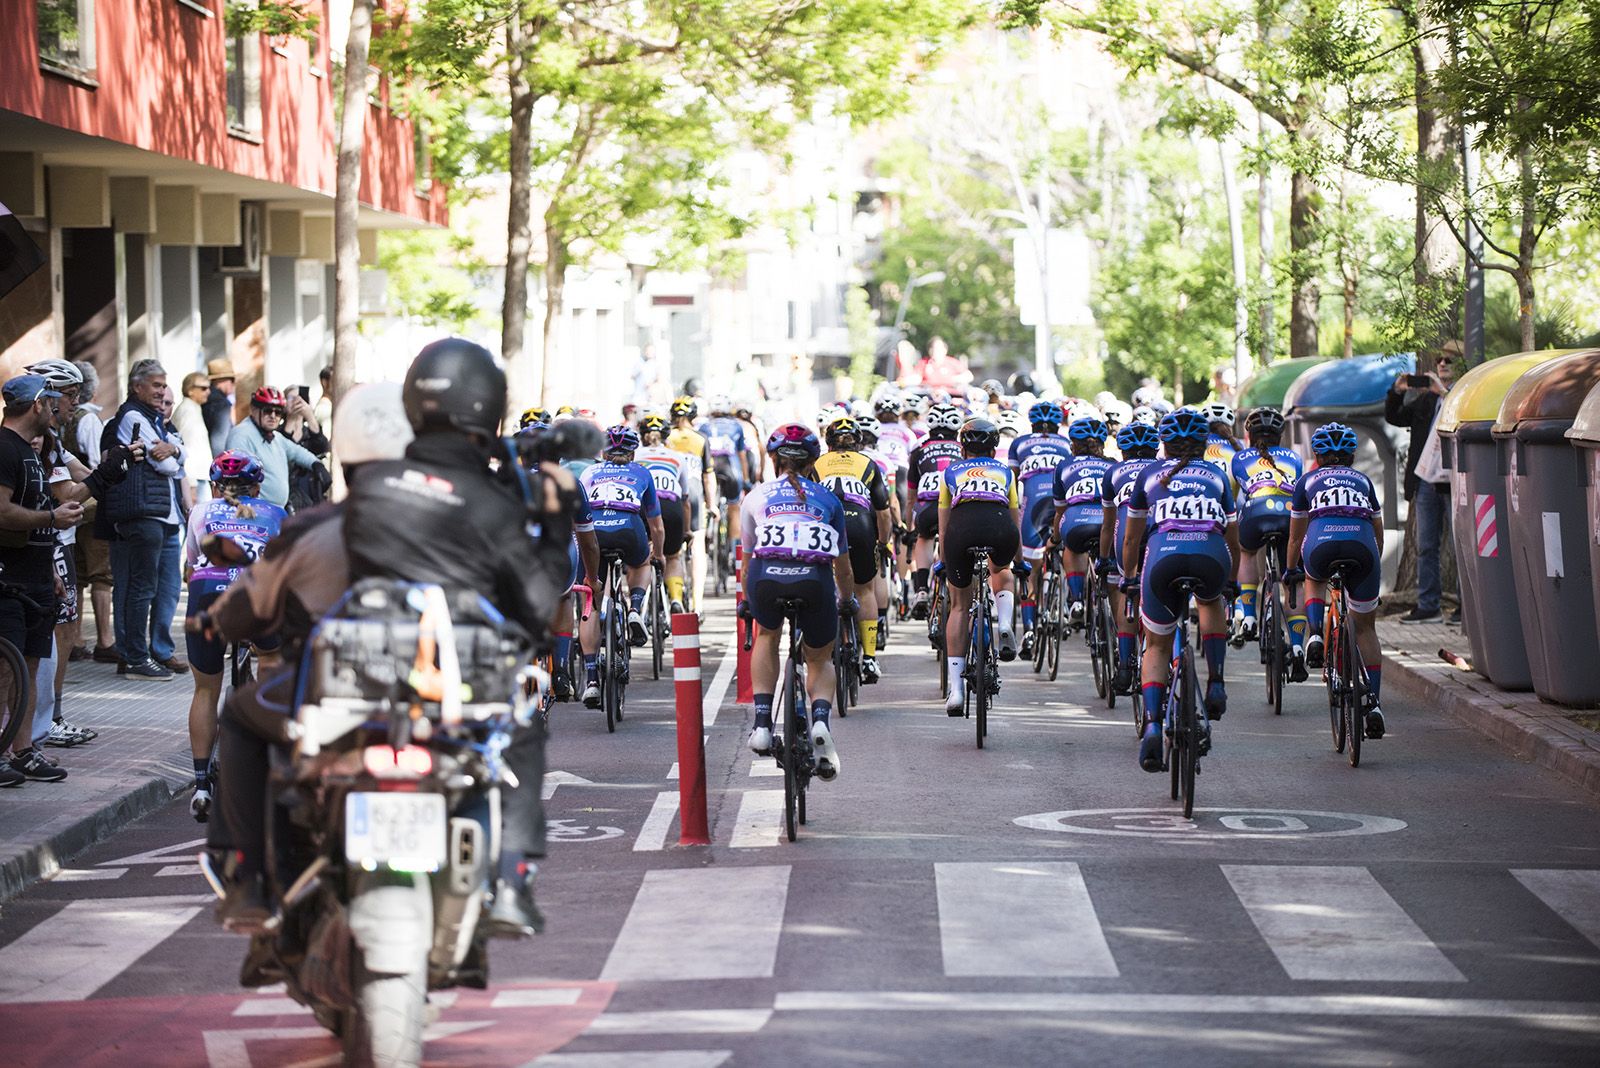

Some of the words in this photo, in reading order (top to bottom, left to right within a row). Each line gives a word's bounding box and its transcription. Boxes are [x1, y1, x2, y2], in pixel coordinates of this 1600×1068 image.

[922, 475, 940, 491] 45
[615, 487, 635, 503] 34
[769, 503, 807, 514] Roland
[210, 523, 248, 531] Roland
[761, 525, 785, 547] 33
[808, 526, 832, 553] 33
[1111, 814, 1309, 831] 30
